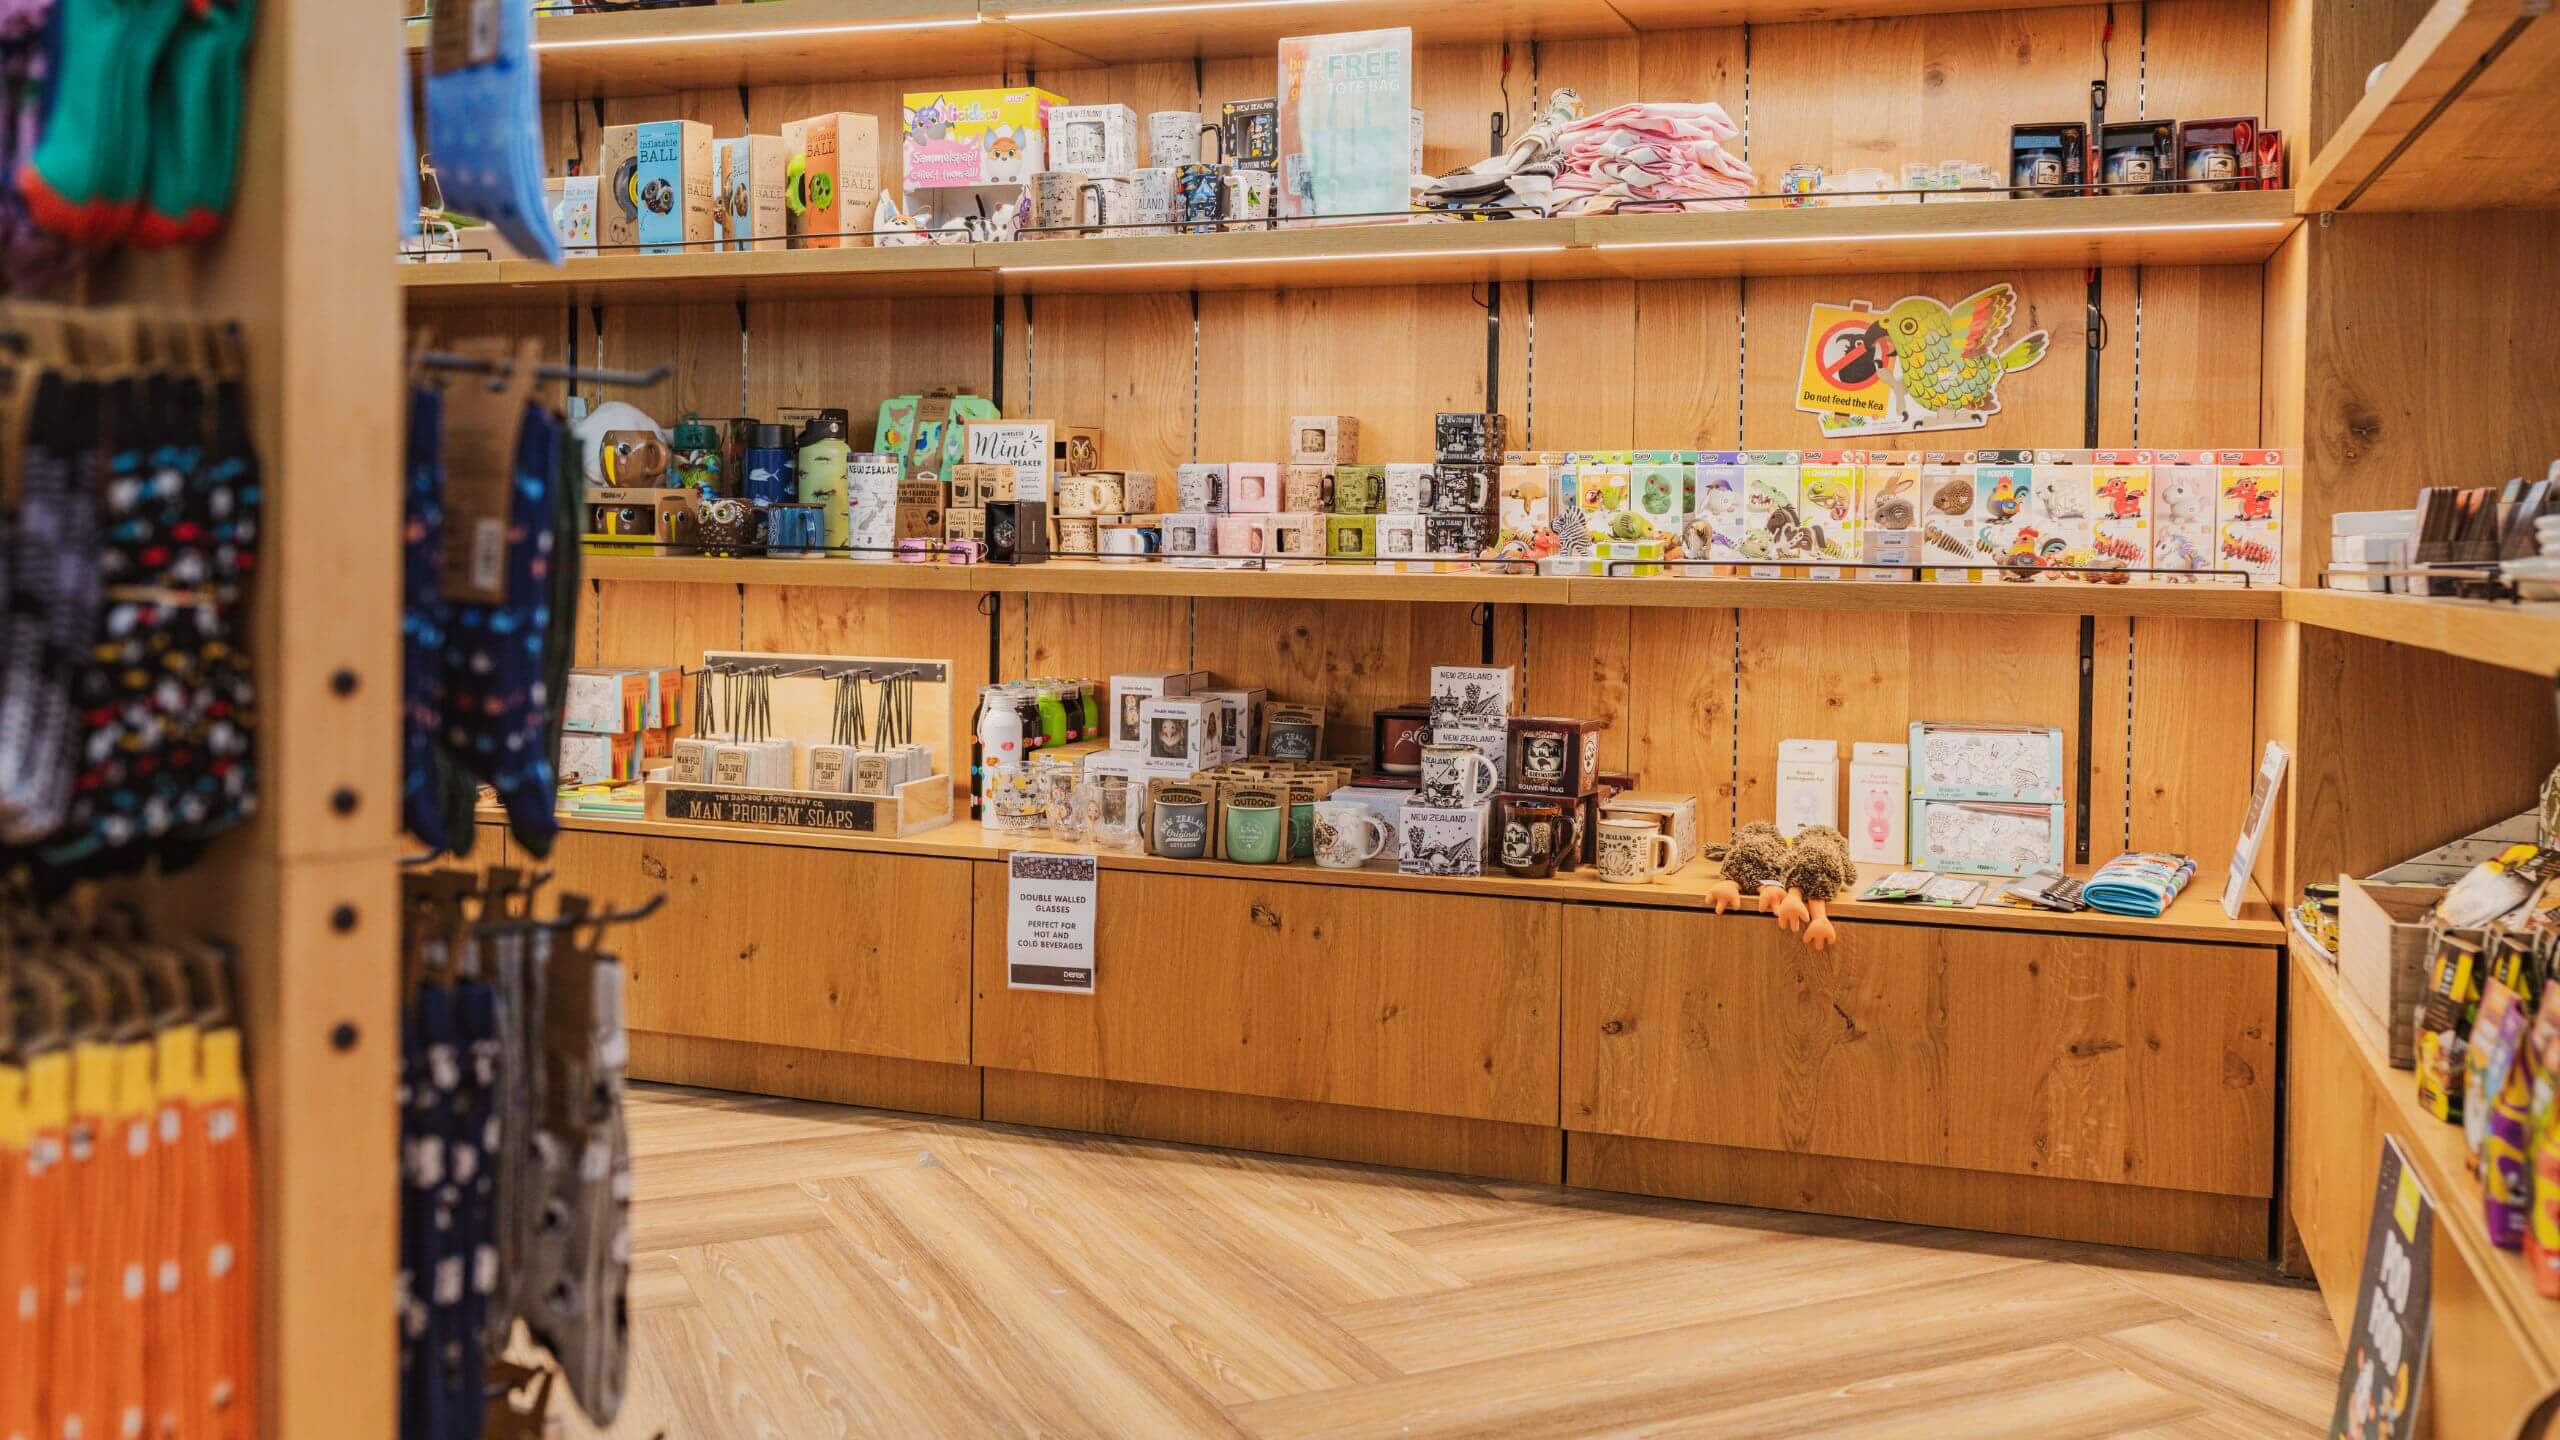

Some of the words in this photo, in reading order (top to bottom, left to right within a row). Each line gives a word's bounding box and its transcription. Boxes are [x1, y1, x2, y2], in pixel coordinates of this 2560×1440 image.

[1328, 49, 1400, 80] FREE
[1328, 80, 1366, 96] TOTE
[1368, 78, 1400, 93] BAG
[1251, 102, 1274, 110] ZEALAND
[639, 138, 678, 149] Inflatable
[807, 142, 835, 157] BALL
[639, 149, 678, 163] BALL
[841, 177, 874, 191] BALL
[687, 184, 712, 198] BALL
[755, 190, 783, 199] BALL
[1804, 391, 1815, 401] Do
[1816, 394, 1831, 404] not
[1831, 395, 1851, 407] feed
[1852, 396, 1867, 409] the
[1868, 400, 1884, 411] Kea
[974, 431, 1030, 459] Mini
[1010, 459, 1042, 467] SPEAKER
[848, 465, 864, 474] NEW
[1440, 671, 1456, 679] NEW
[1457, 672, 1493, 680] ZEALAND
[1443, 733, 1459, 742] NEW
[1459, 734, 1496, 743] ZEALAND
[677, 756, 700, 765] MAN-FLU
[1424, 756, 1452, 765] ZEALAND
[681, 764, 694, 773] SOAP
[723, 772, 736, 781] SOAP
[821, 771, 834, 780] SOAP
[860, 771, 883, 780] MAN-FLU
[864, 780, 877, 788] SOAP
[764, 795, 811, 807] APOTHECARY
[812, 800, 825, 808] CO.
[1160, 794, 1202, 803] OUTDOOR
[1234, 798, 1276, 807] OUTDOOR
[689, 800, 722, 820] MAN
[807, 809, 854, 829] SOAPS
[1410, 813, 1429, 822] NEW
[1430, 813, 1467, 823] ZEALAND
[1160, 817, 1174, 834] NEW
[1166, 828, 1200, 840] Original
[1020, 893, 1052, 902] DOUBLE
[1054, 895, 1086, 904] WALLED
[1035, 905, 1070, 914] GLASSES
[1027, 920, 1059, 929] PERFECT
[1061, 921, 1077, 930] FOR
[1034, 931, 1050, 939] HOT
[1052, 931, 1069, 939] AND
[1017, 939, 1038, 948] COLD
[1040, 941, 1083, 950] BEVERAGES
